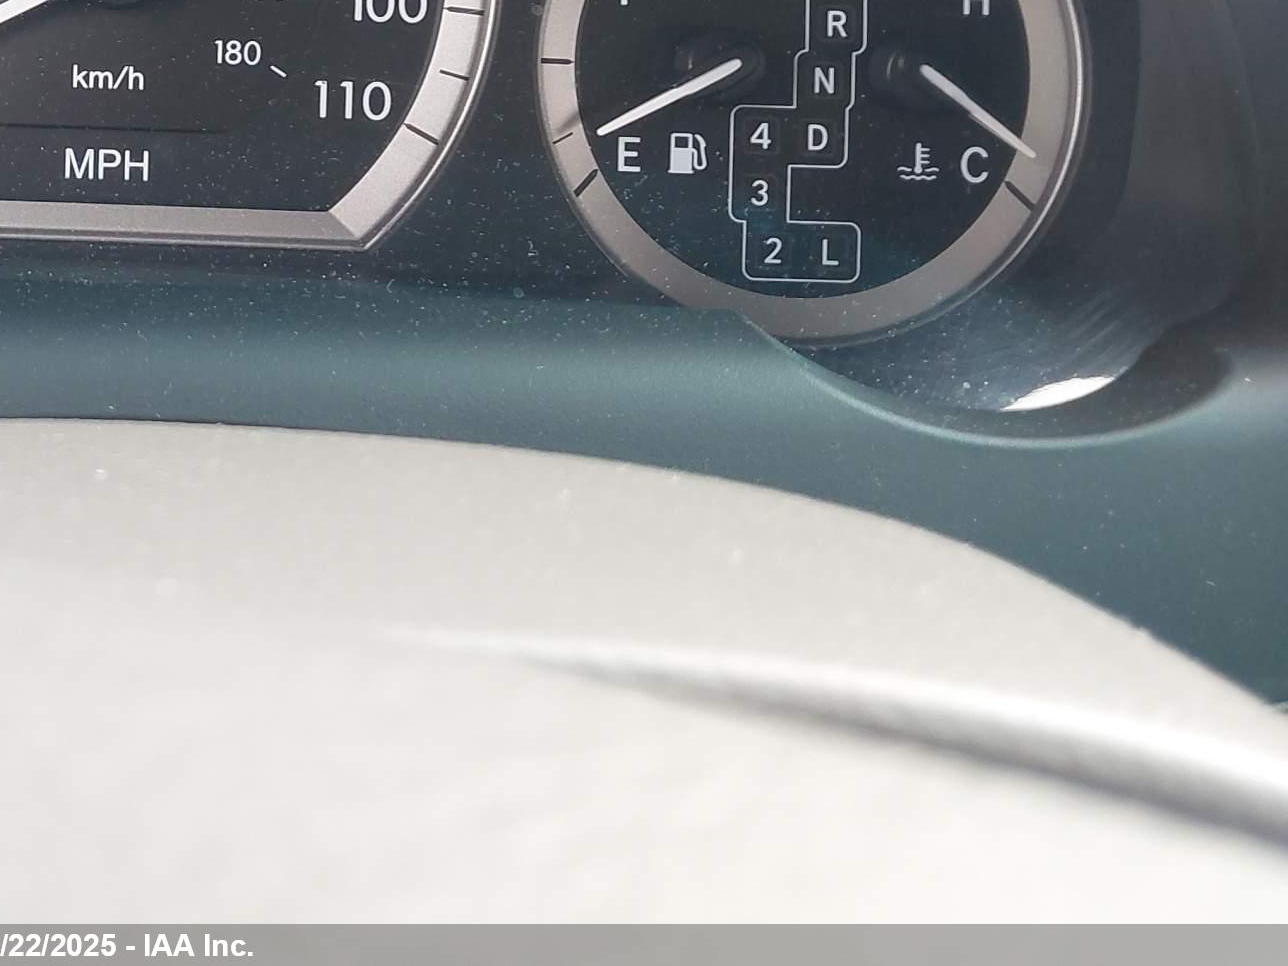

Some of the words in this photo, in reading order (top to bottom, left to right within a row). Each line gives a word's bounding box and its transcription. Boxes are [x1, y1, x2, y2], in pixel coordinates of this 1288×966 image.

[828, 11, 846, 37] R
[215, 40, 261, 65] 180
[73, 65, 143, 90] km/h
[815, 67, 834, 93] N
[315, 81, 391, 120] 110
[751, 123, 771, 149] 4
[808, 124, 827, 150] D
[65, 148, 148, 181] MPH
[618, 137, 640, 172] E
[961, 147, 988, 183] C
[751, 180, 768, 206] 3
[764, 238, 781, 263] 2
[822, 239, 839, 265] L
